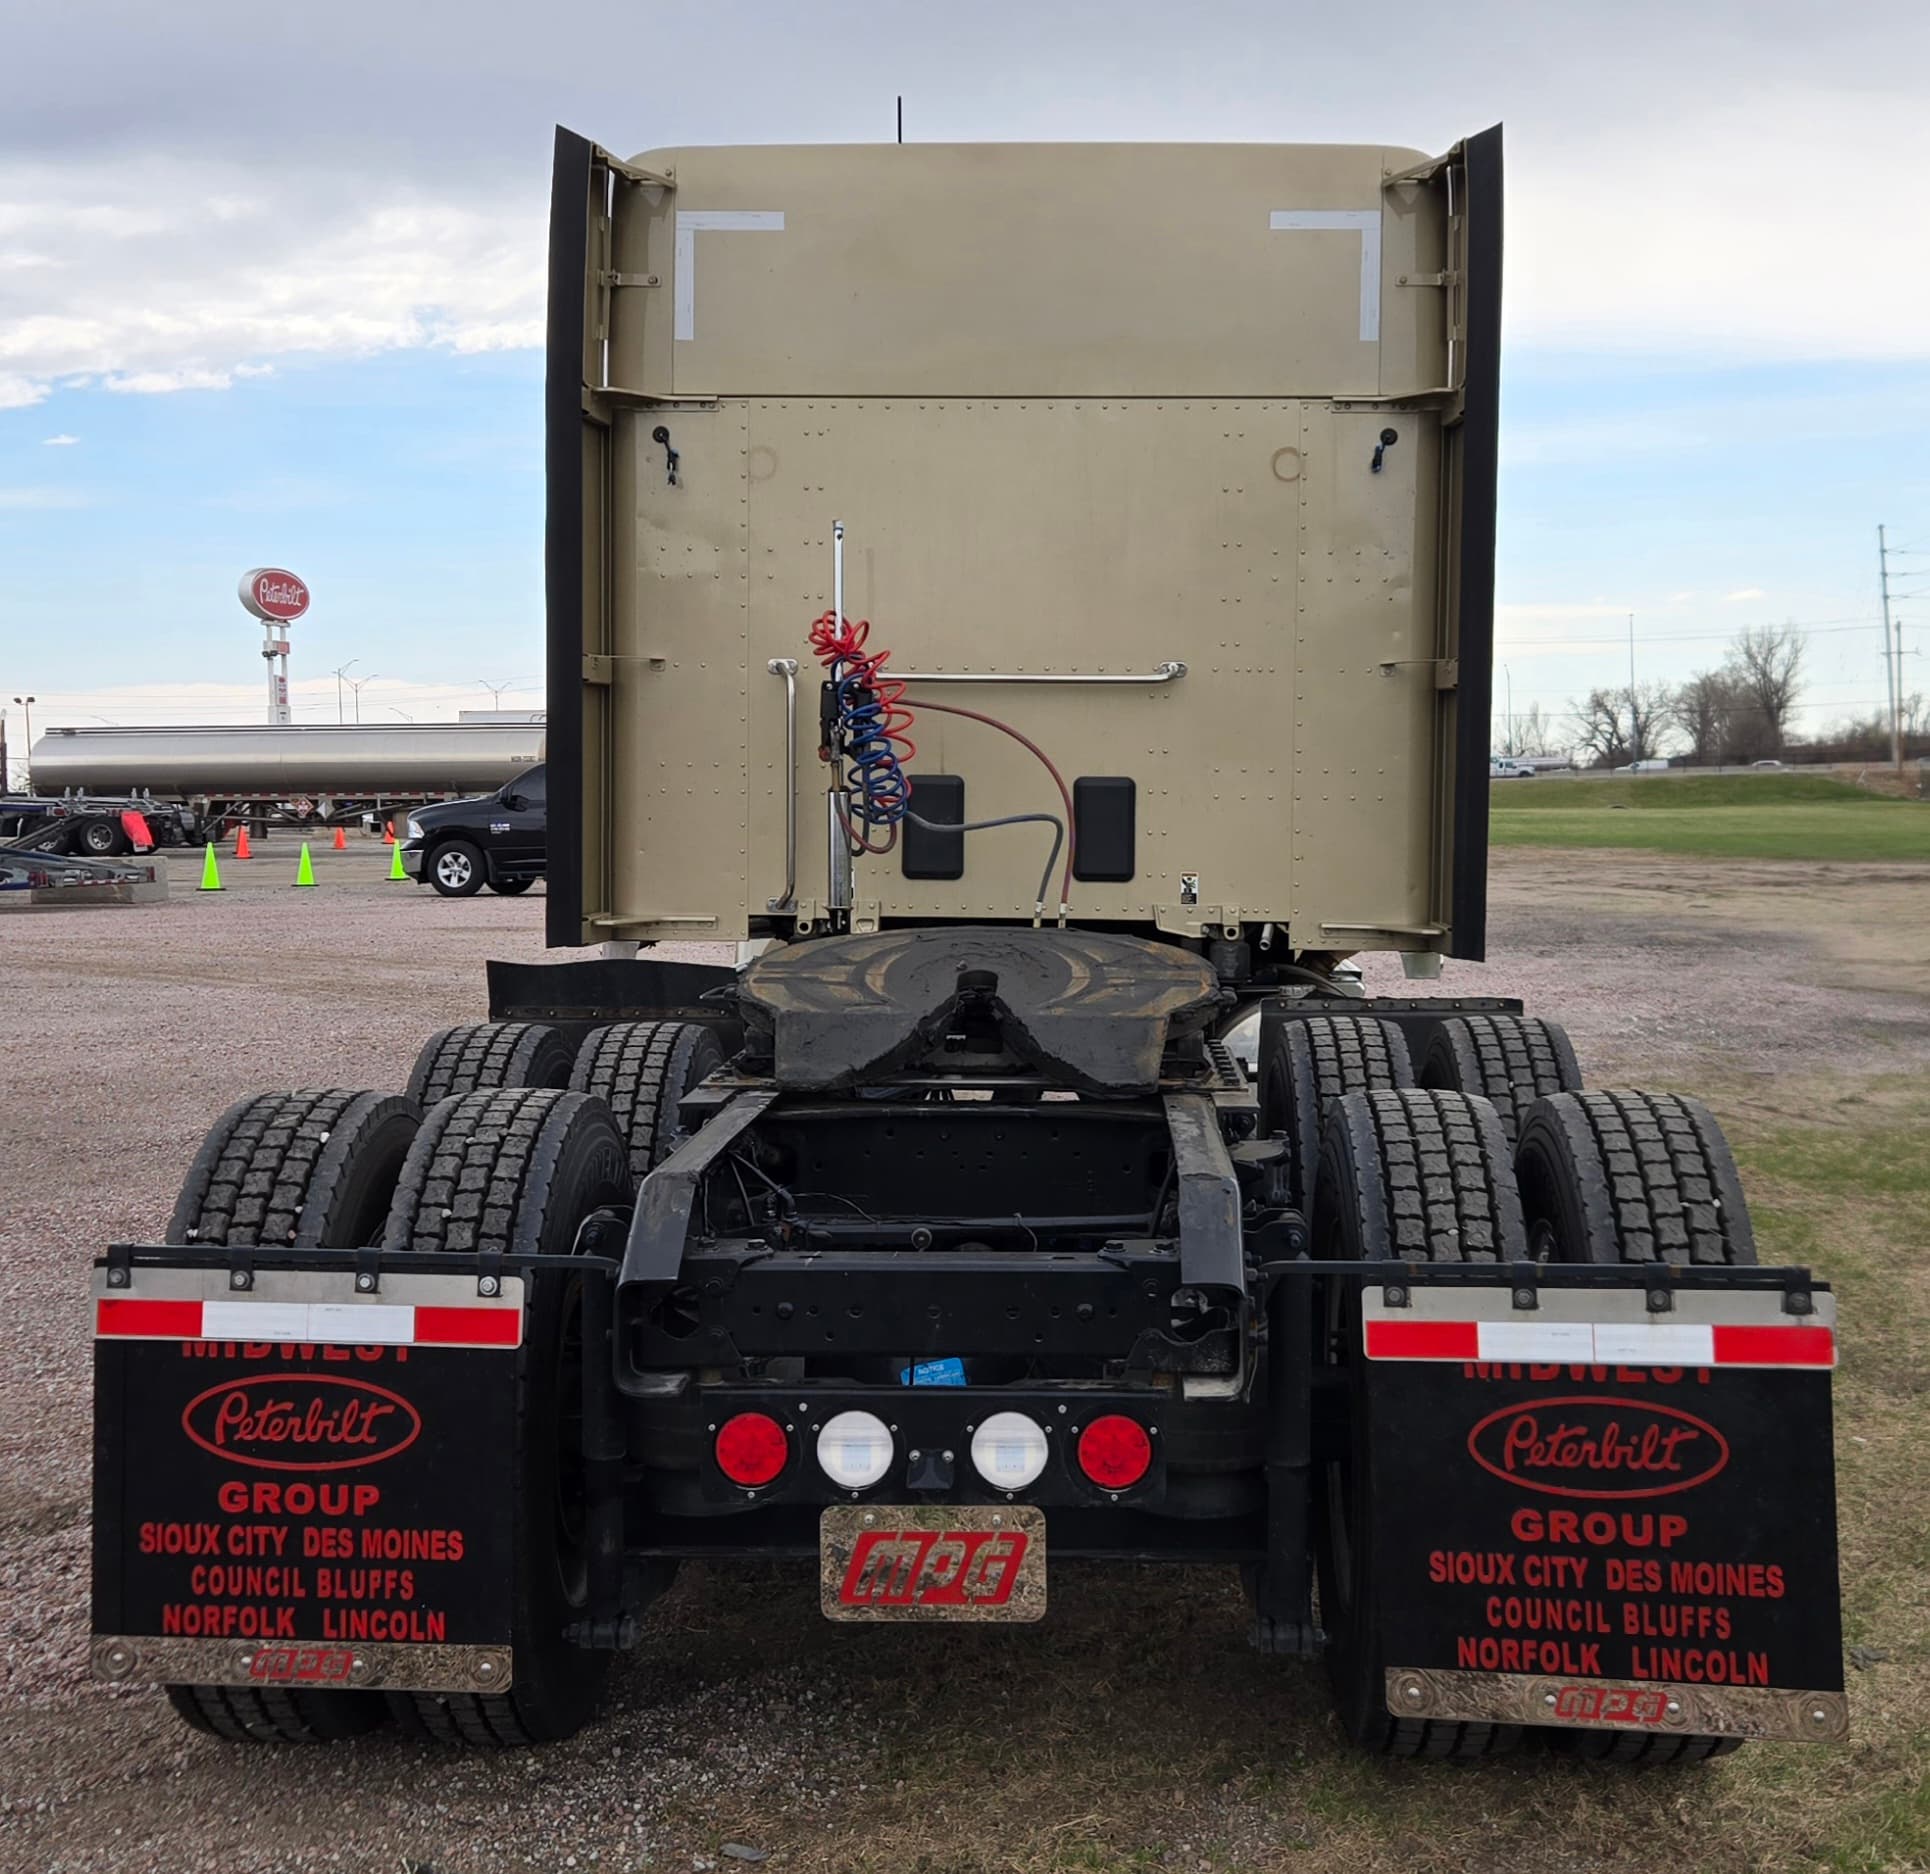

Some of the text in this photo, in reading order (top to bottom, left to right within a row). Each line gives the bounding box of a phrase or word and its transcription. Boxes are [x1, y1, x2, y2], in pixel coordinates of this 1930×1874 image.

[260, 578, 304, 606] Peterbilt
[215, 1391, 394, 1445] Peterbilt
[1504, 1414, 1699, 1471] Peterbilt
[218, 1482, 380, 1516] GROUP
[140, 1523, 464, 1561] SIOUX CITY DES MOINES
[1511, 1509, 1688, 1547] GROUP
[191, 1566, 415, 1601] COUNCIL BLUFFS
[846, 1534, 1024, 1604] MPG
[1429, 1551, 1785, 1598] SIOUX CITY DES MOINES
[163, 1605, 446, 1642] NORFOLK LINCOLN
[1486, 1597, 1732, 1639] COUNCIL BLUFFS
[252, 1649, 354, 1681] MPG
[1458, 1637, 1769, 1685] NORFOLK LINCOLN
[1555, 1687, 1668, 1723] MPG
